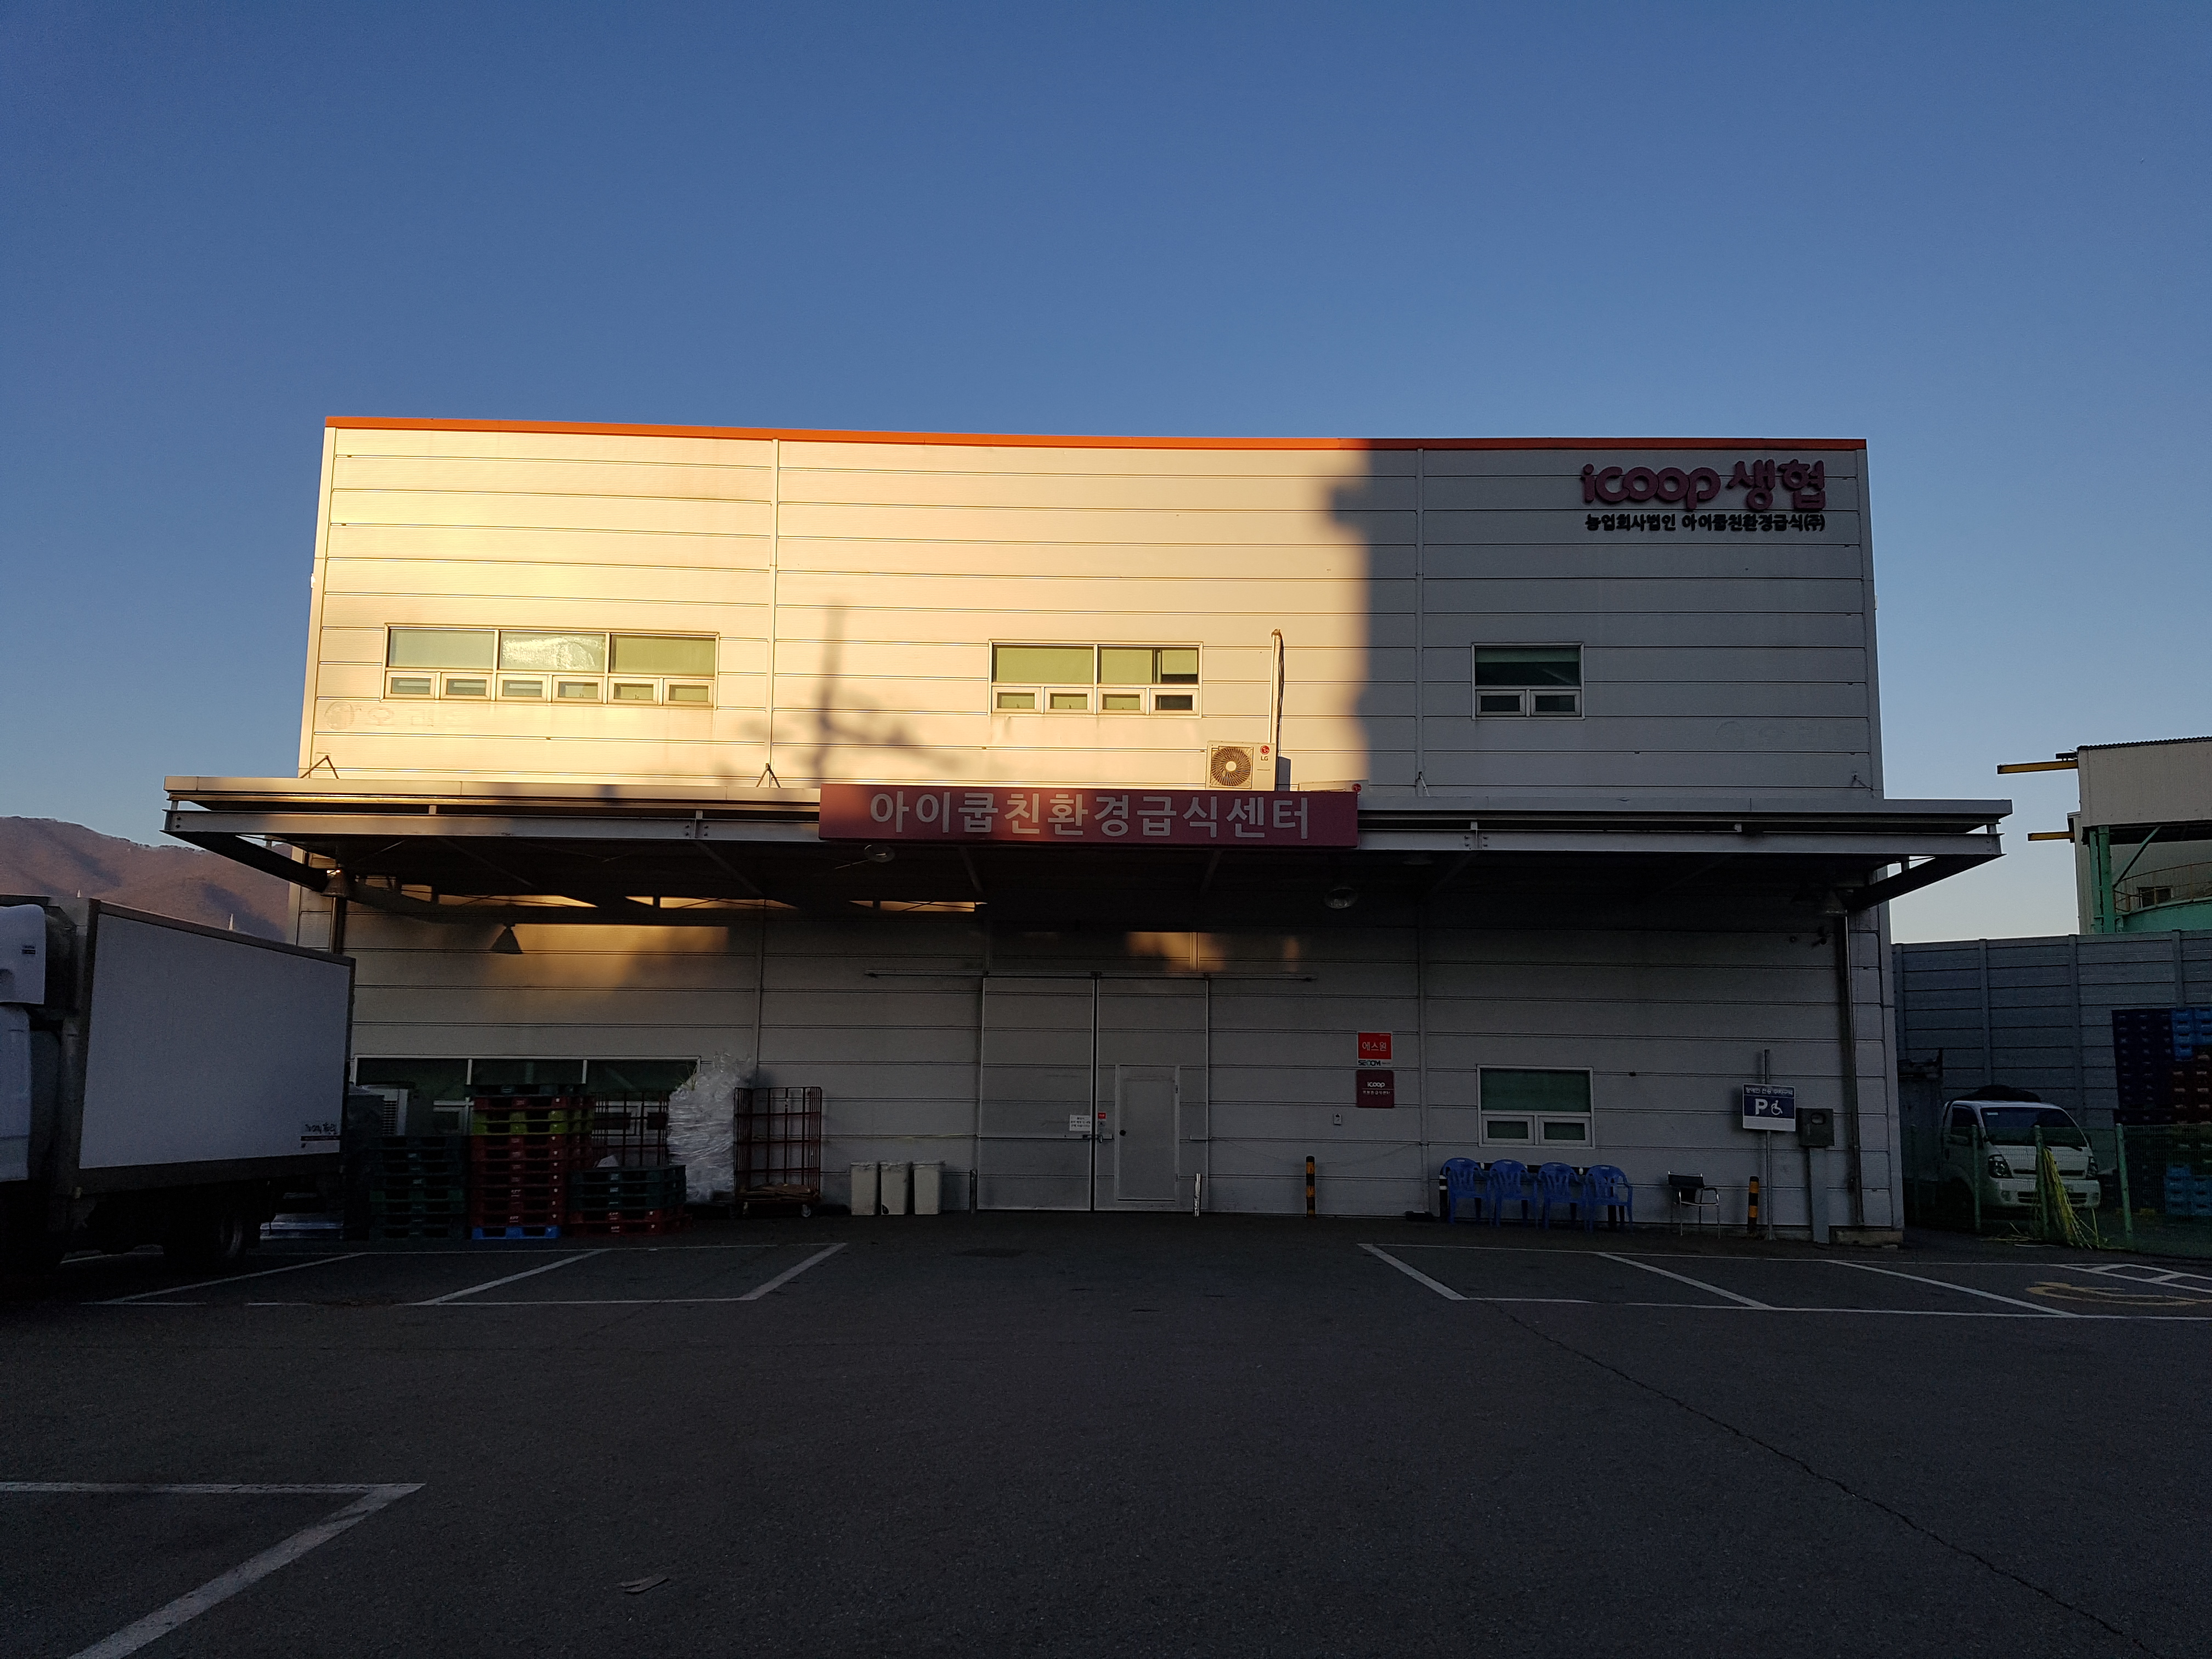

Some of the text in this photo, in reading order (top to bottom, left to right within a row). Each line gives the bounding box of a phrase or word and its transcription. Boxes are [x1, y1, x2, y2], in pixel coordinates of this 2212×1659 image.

[1585, 514, 1676, 531] 농업회사법인
[870, 791, 1308, 840] 아이쿱친환경급식센터
[1362, 1041, 1386, 1051] 에스원
[1755, 1098, 1768, 1115] P
